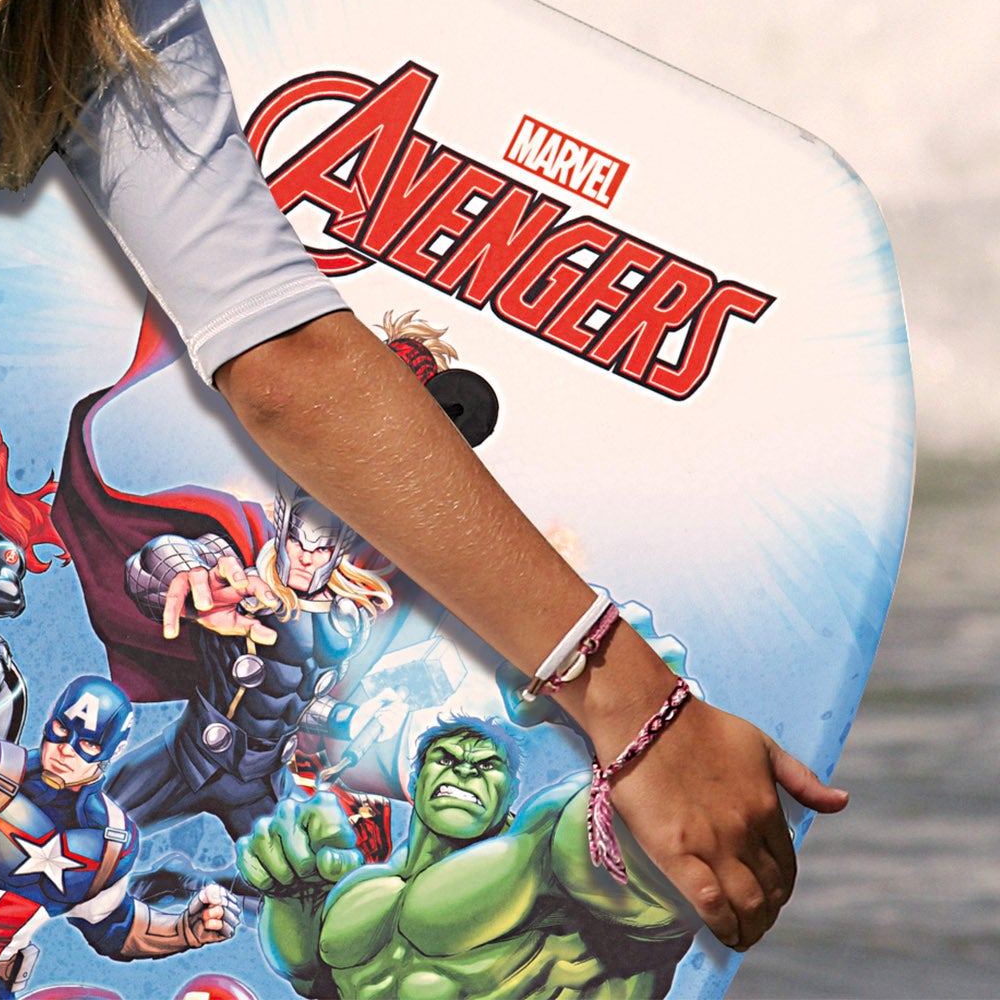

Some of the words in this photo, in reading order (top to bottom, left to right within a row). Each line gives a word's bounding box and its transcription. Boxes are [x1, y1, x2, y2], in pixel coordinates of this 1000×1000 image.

[508, 118, 622, 205] MARVEL
[264, 60, 777, 402] AVENGERS
[64, 691, 101, 732] A
